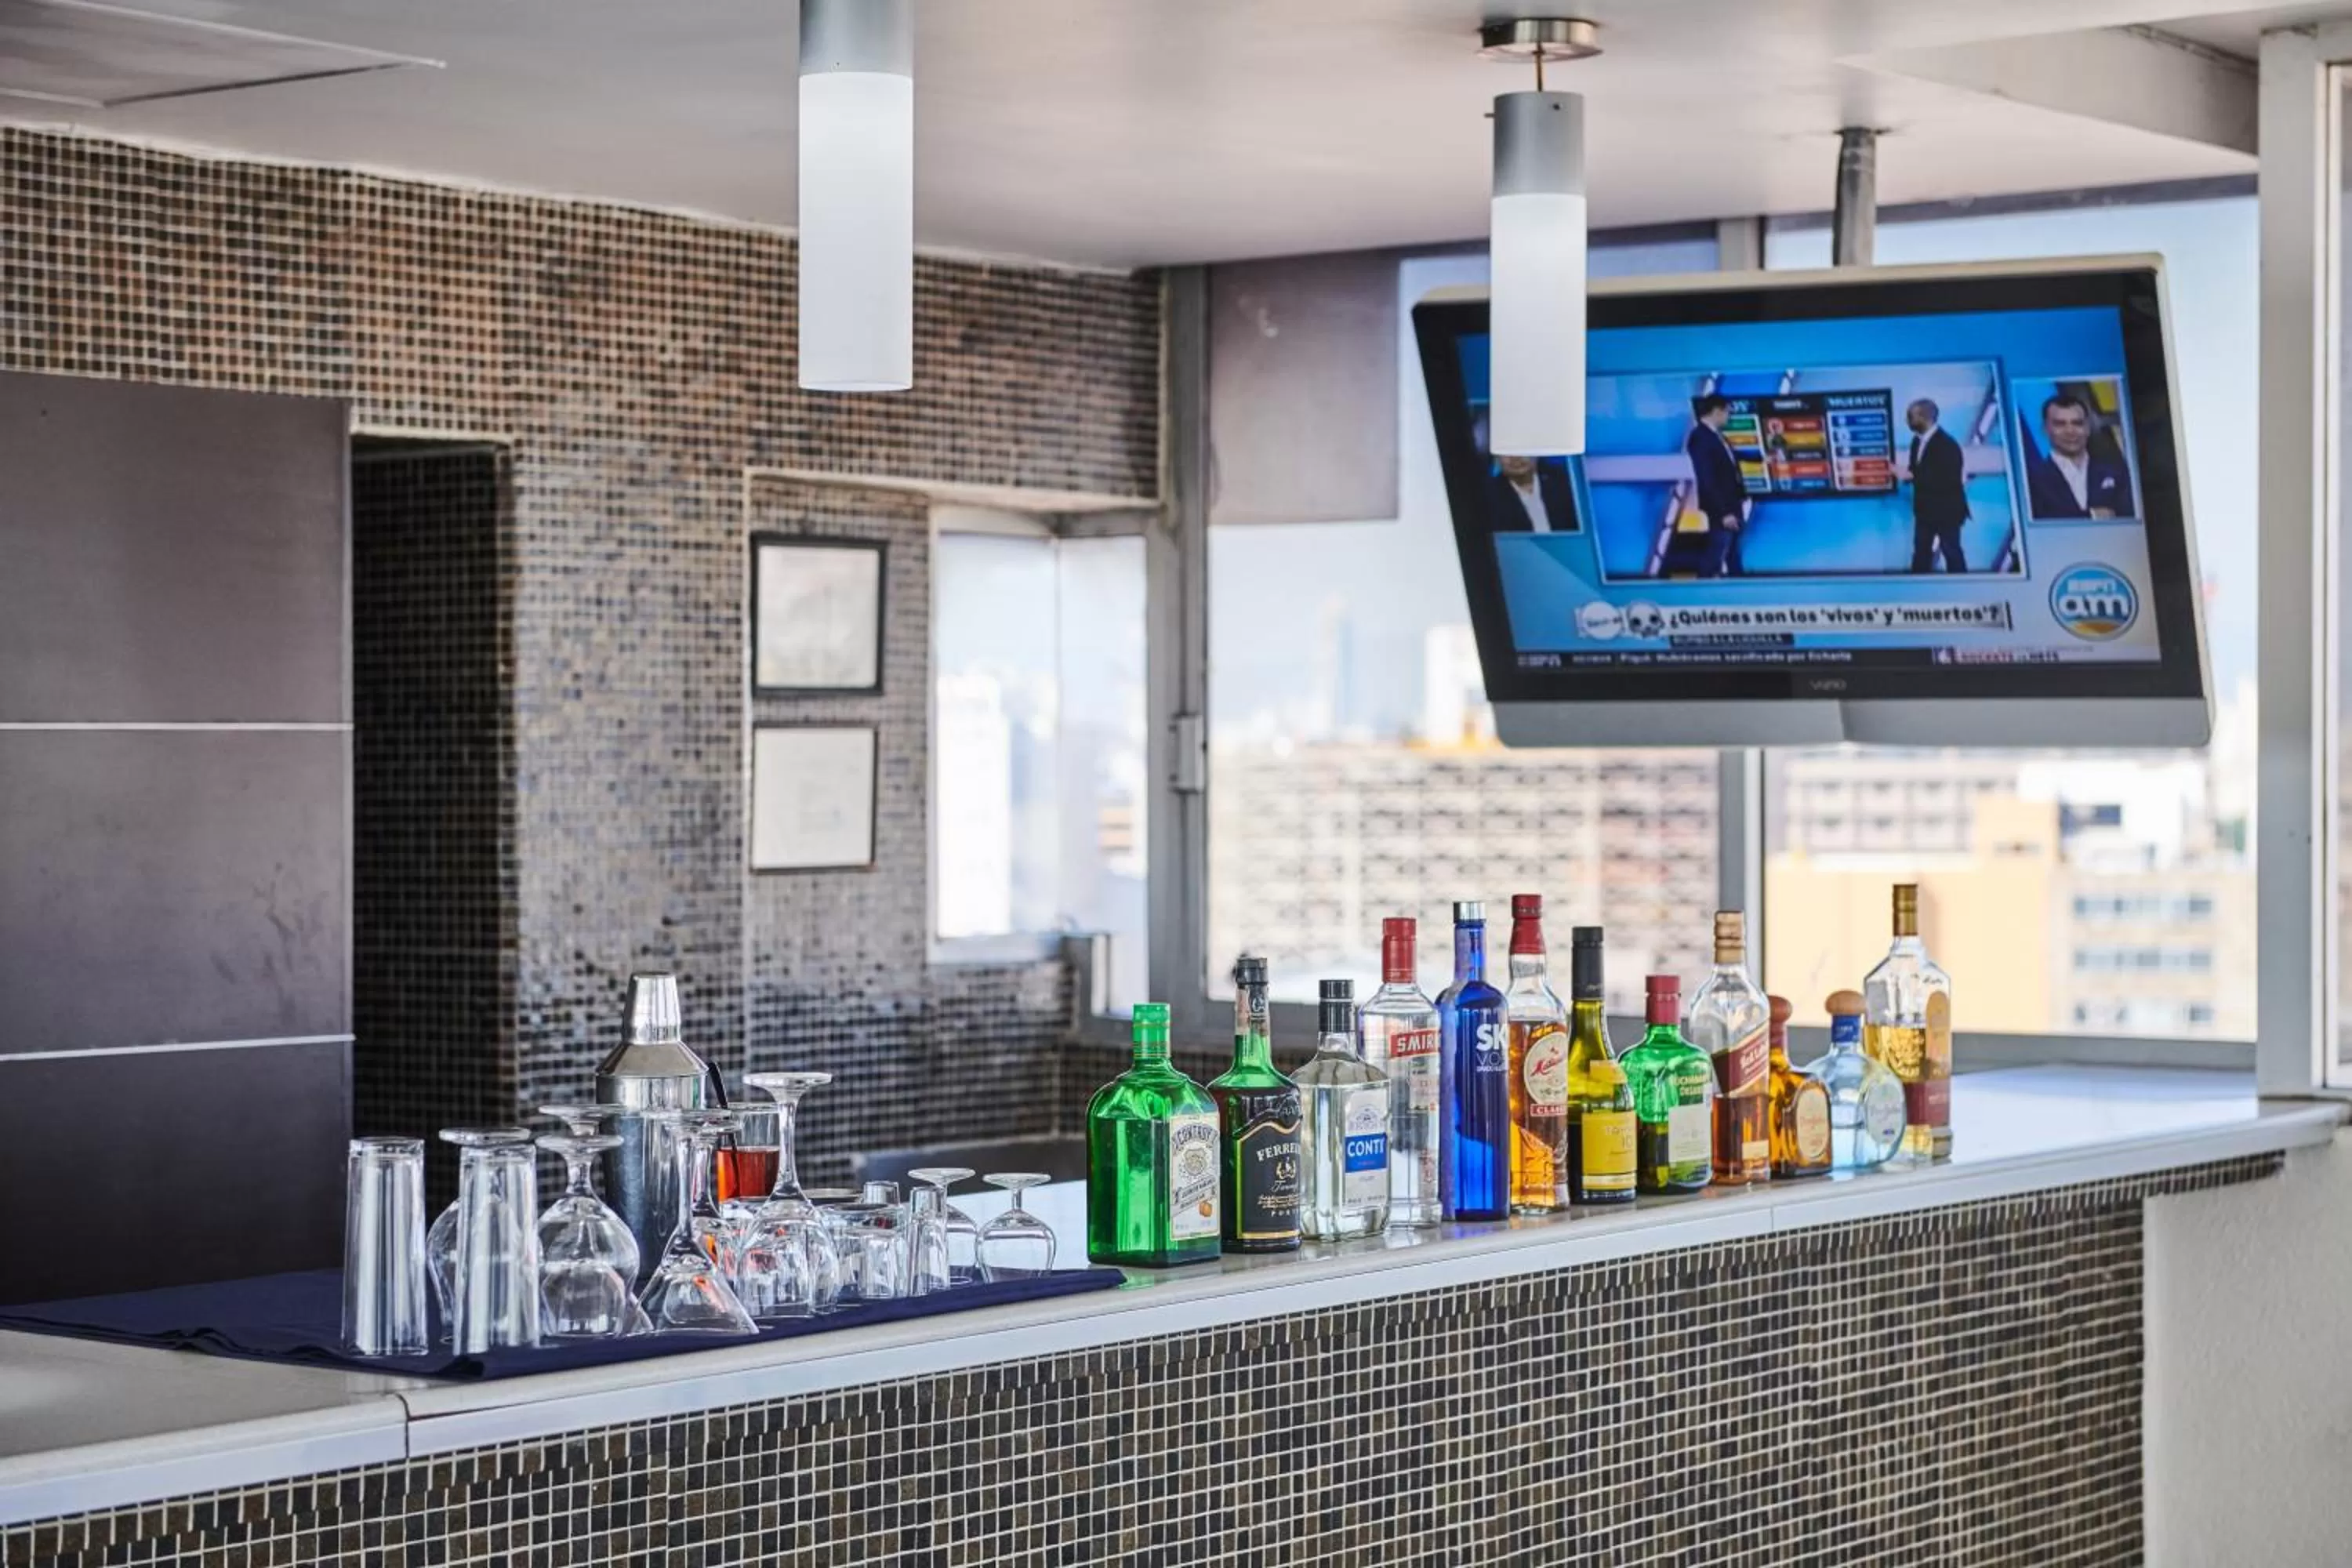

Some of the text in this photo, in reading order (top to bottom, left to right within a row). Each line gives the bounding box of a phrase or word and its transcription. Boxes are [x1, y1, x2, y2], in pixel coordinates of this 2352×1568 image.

[2059, 593, 2129, 617] am
[1670, 608, 1751, 627] ¿Quiénes
[1755, 611, 1787, 624] son
[1788, 608, 1817, 623] los
[1882, 610, 1894, 627] y
